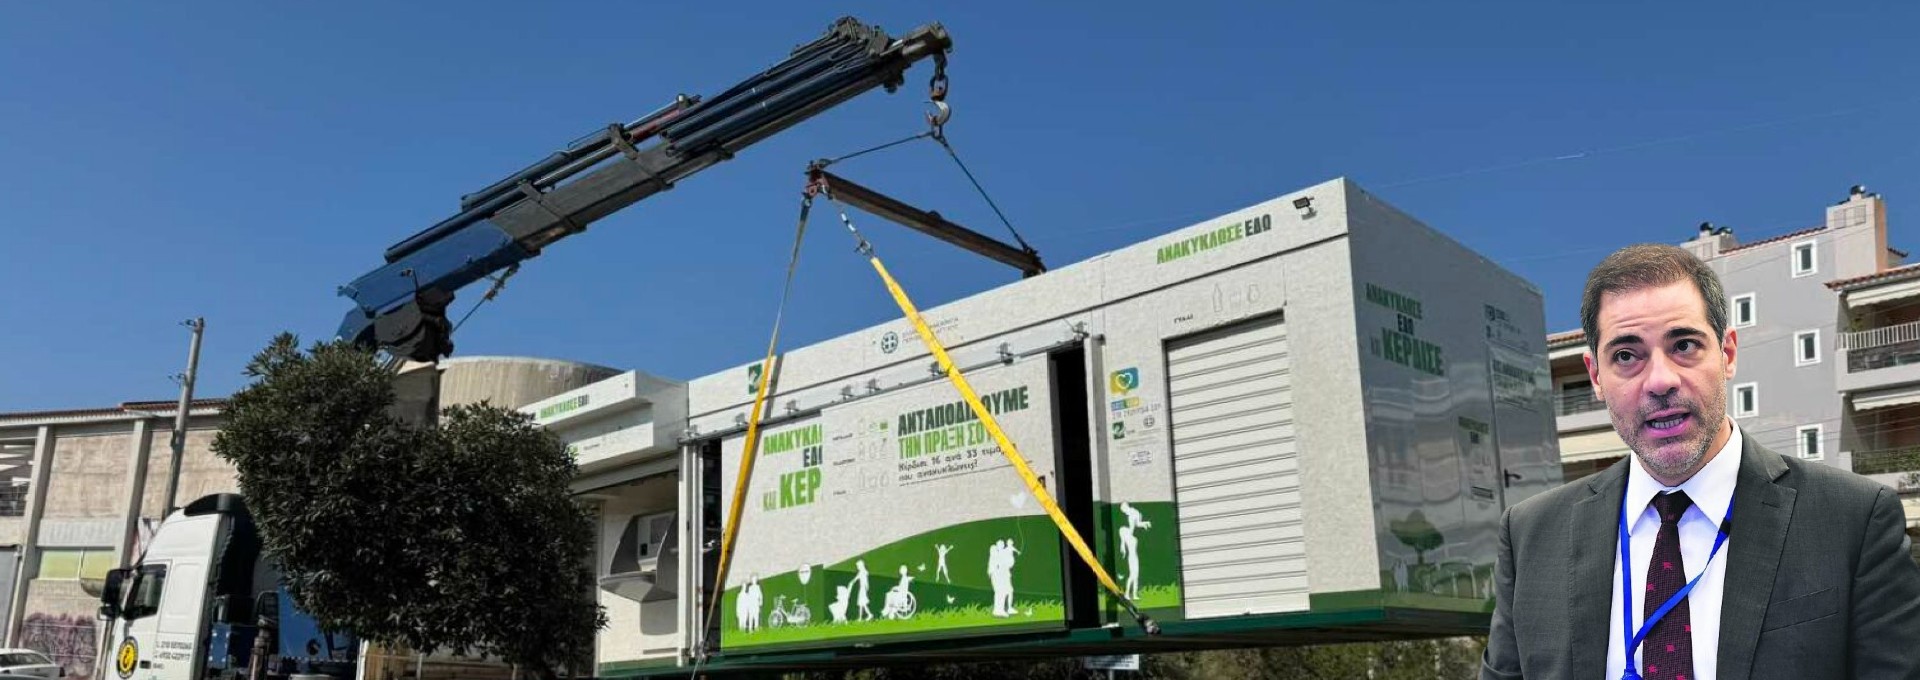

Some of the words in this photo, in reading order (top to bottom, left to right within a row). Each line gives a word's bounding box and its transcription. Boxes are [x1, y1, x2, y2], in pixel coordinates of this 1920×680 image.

[1156, 222, 1242, 264] ΑΝΑΚΥΚΛΩΣΕ
[1245, 214, 1272, 237] ΕΔΩ
[1365, 282, 1423, 320] ΑΝΑΚΥΚΛΩΣΕ
[1397, 313, 1414, 336] ΕΔΩ
[1381, 326, 1445, 377] ΚΕΡΔΙΣΕ
[898, 433, 922, 460] ΤΗΝ
[924, 424, 964, 455] ΠΡΑΞΗ
[966, 449, 978, 459] 33
